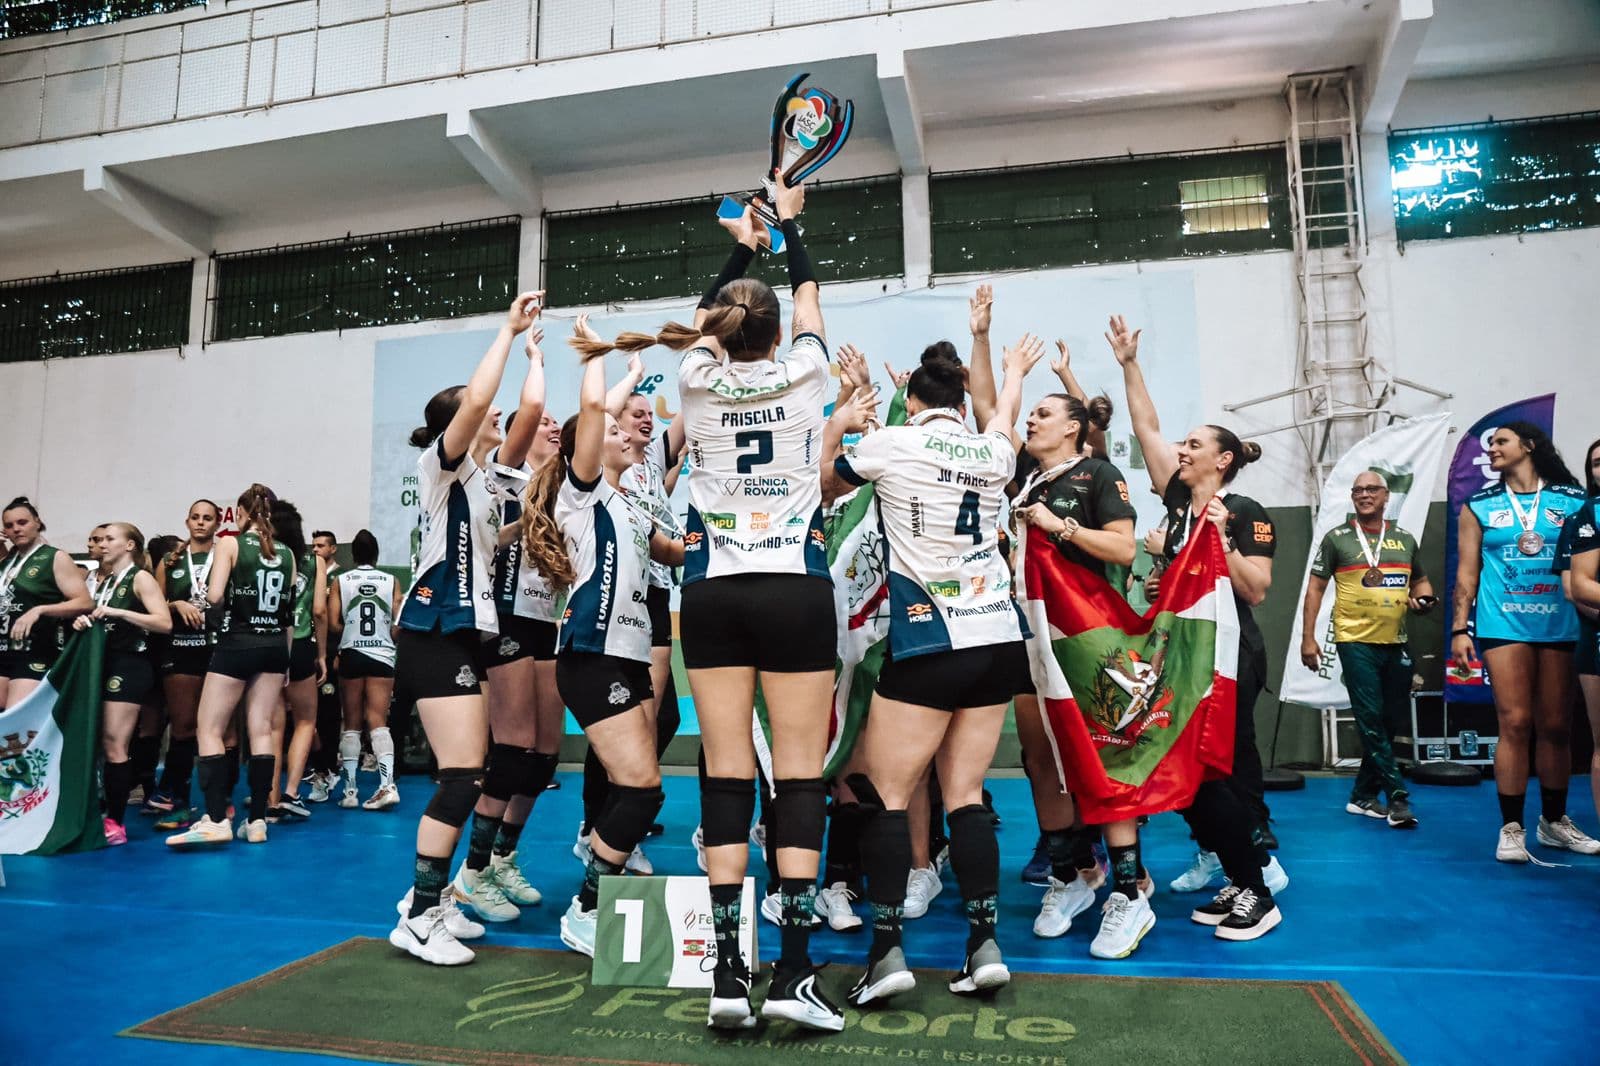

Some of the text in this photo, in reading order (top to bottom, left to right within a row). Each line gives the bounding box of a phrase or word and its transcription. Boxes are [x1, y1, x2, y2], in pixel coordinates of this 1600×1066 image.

[633, 374, 664, 395] 4º
[721, 406, 786, 427] PRISCILA
[744, 476, 788, 486] CLÍNICA
[744, 487, 789, 496] ROVANI
[955, 489, 983, 546] 4
[1503, 547, 1556, 557] HAAN
[256, 569, 284, 613] 18
[1502, 602, 1559, 613] BRUSQUE
[360, 602, 375, 636] 8
[617, 613, 648, 629] denke
[615, 899, 644, 963] 1
[571, 1027, 702, 1044] FUNDAÇÃO
[898, 1049, 930, 1059] DE
[942, 1050, 1068, 1066] ESPORTE
